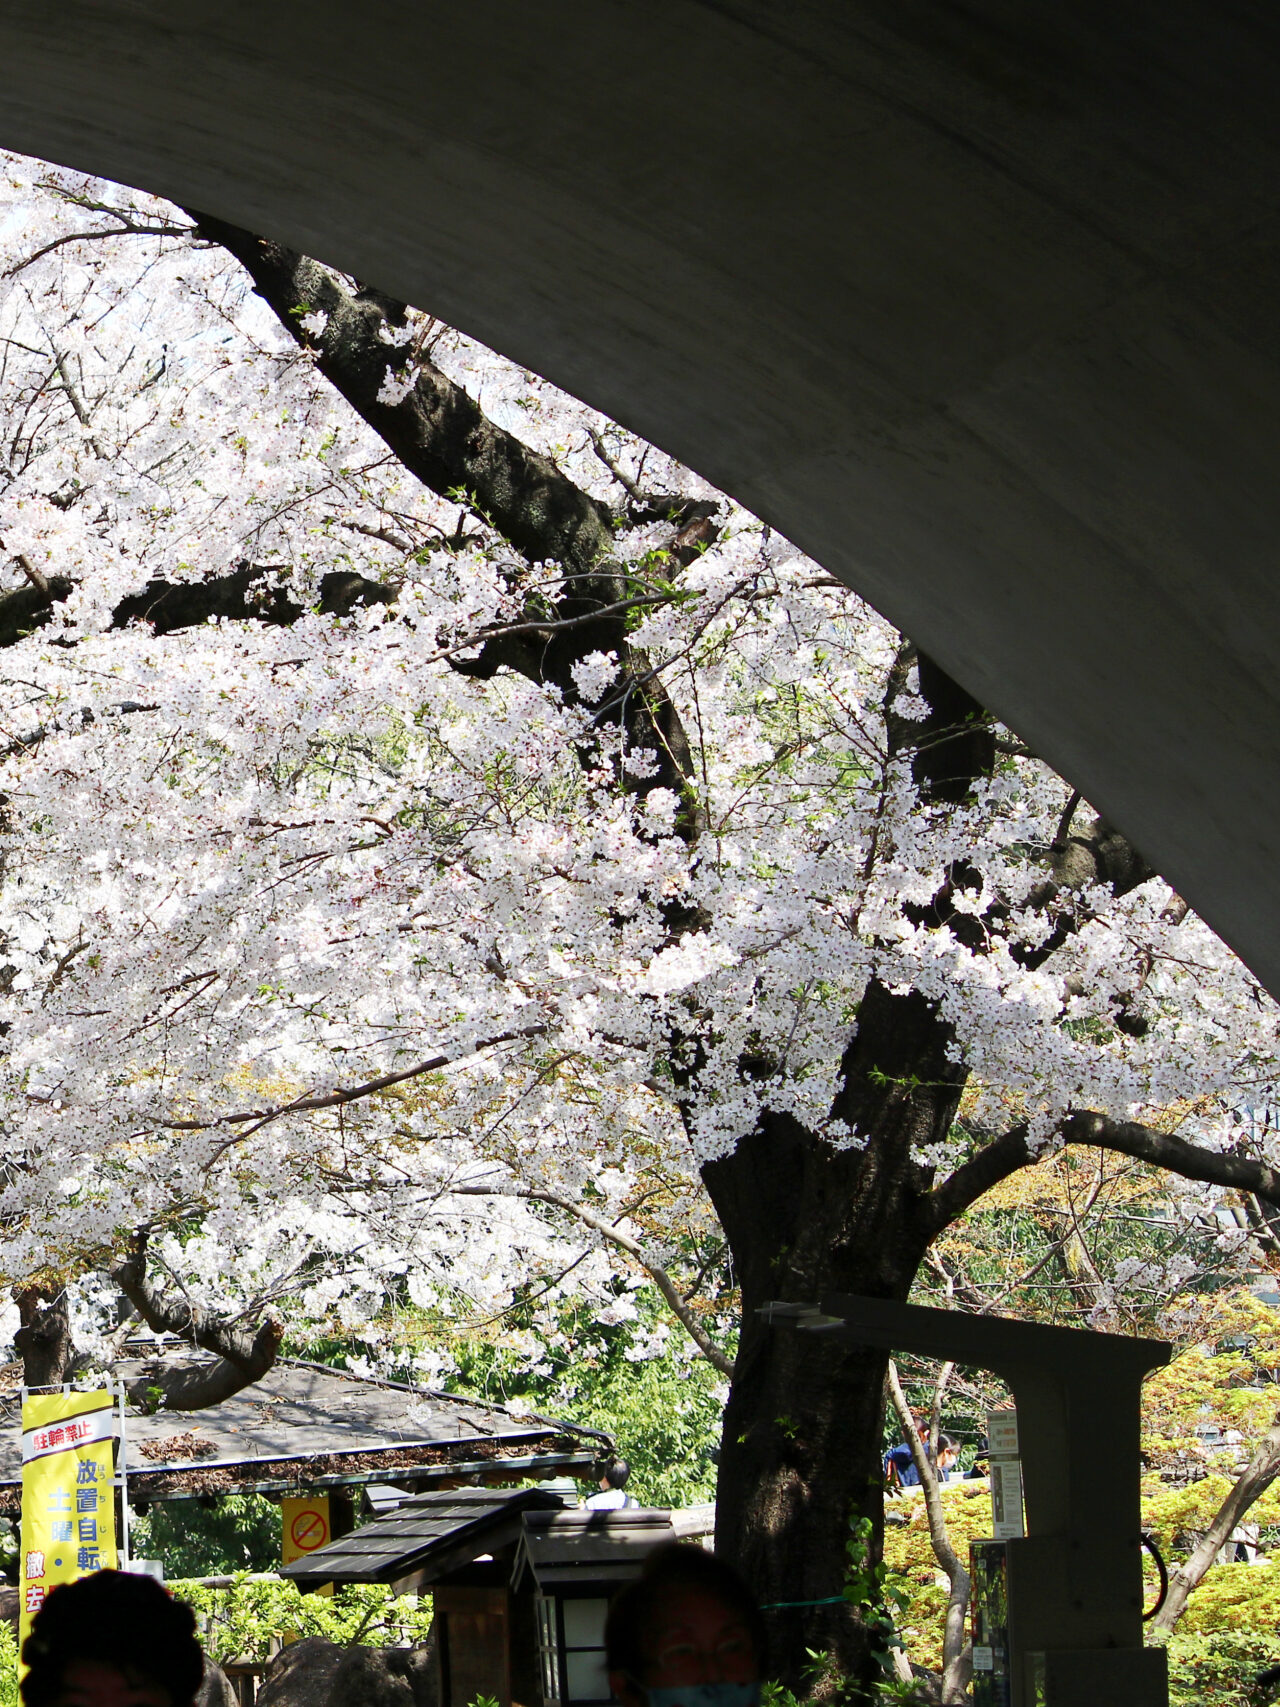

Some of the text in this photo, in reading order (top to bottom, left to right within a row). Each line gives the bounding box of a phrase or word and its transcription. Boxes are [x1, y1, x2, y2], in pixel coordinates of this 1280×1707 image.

[33, 1420, 93, 1450] 駐輪禁止
[47, 1487, 72, 1594] 土曜・
[76, 1459, 101, 1581] 放置自転
